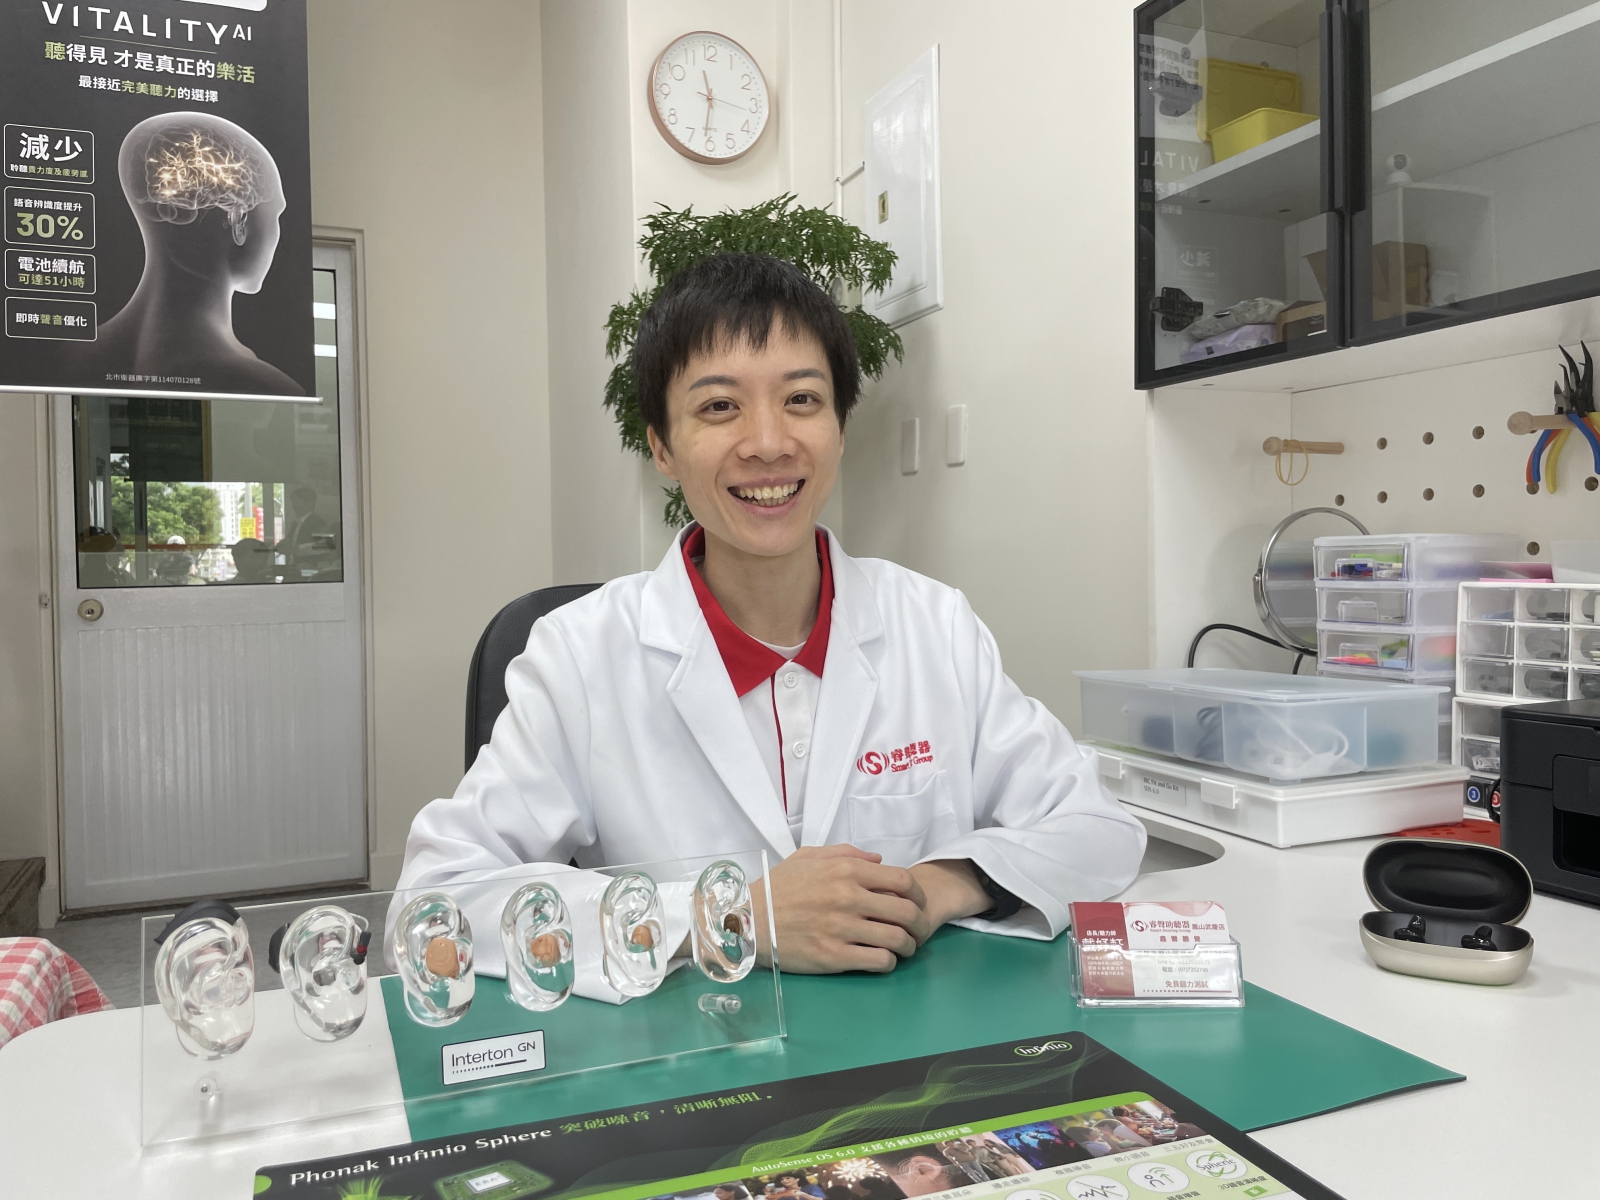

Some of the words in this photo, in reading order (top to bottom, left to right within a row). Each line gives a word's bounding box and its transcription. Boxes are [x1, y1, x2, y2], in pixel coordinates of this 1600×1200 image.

[42, 1, 228, 45] VITALITY
[233, 24, 251, 41] AI
[684, 48, 695, 66] 11
[703, 44, 718, 62] 12
[45, 41, 108, 65] 聽得見
[113, 49, 256, 83] 才是真正的樂活
[668, 63, 686, 81] 10
[78, 75, 219, 103] 最接近完美聽力的選擇
[741, 74, 752, 90] 2
[660, 83, 671, 100] 9
[749, 98, 759, 114] 3
[668, 108, 678, 125] 8
[686, 126, 696, 143] 7
[740, 119, 750, 134] 4
[20, 132, 83, 161] 減少
[704, 136, 716, 152] 6
[725, 133, 736, 150] 5
[13, 197, 82, 212] 語音辨識度提升
[16, 212, 84, 241] 30%
[18, 256, 85, 275] 電池續航
[18, 273, 85, 288] 可達51小時
[16, 312, 87, 327] 即時聲音優化
[913, 756, 933, 764] Group
[452, 1047, 513, 1067] Interton
[518, 1041, 535, 1052] GN
[290, 1160, 380, 1186] Phonak
[388, 1144, 467, 1167] Infinio
[475, 1128, 552, 1149] Sphere
[752, 1157, 813, 1174] AutoSense
[816, 1152, 833, 1161] OS
[836, 1148, 855, 1158] 6.0
